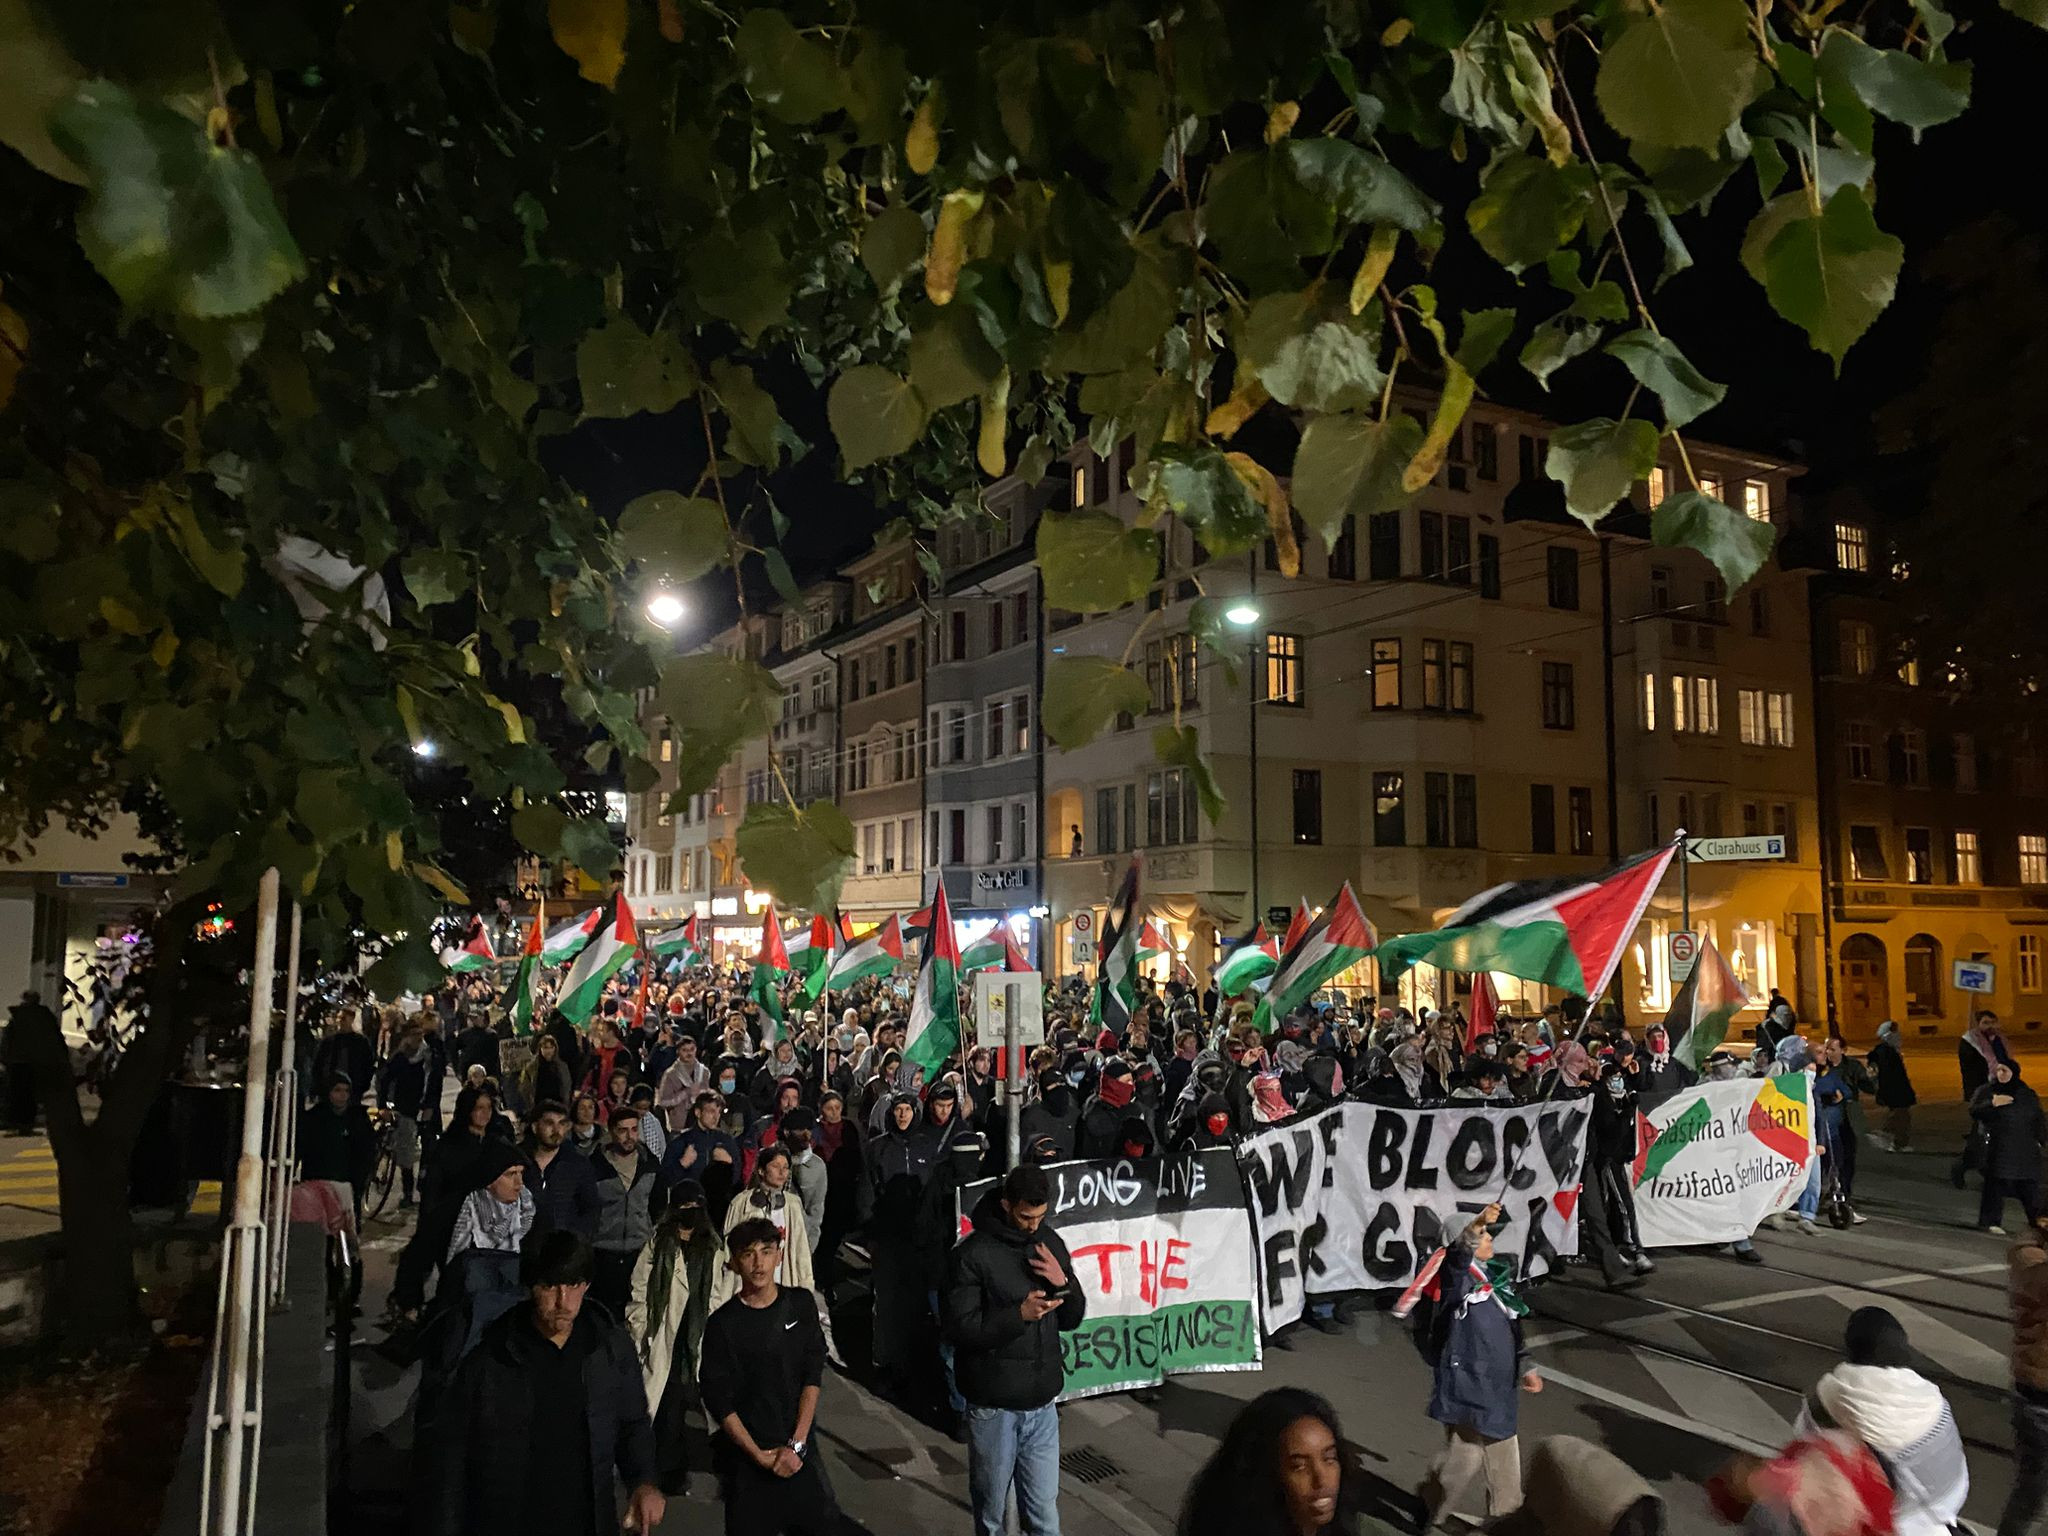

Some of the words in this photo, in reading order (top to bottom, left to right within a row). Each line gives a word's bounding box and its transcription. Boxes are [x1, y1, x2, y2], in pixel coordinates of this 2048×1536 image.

[1706, 841, 1761, 856] Clarahuus
[977, 872, 994, 889] Star
[1003, 869, 1024, 888] Grill
[1055, 1160, 1142, 1214] LONG
[1157, 1156, 1206, 1199] LIVE
[1238, 1111, 1343, 1217] WE
[1368, 1108, 1588, 1191] BLOCK
[1650, 1168, 1736, 1199] Intifada
[1071, 1238, 1192, 1309] THE
[1265, 1211, 1328, 1309] FR
